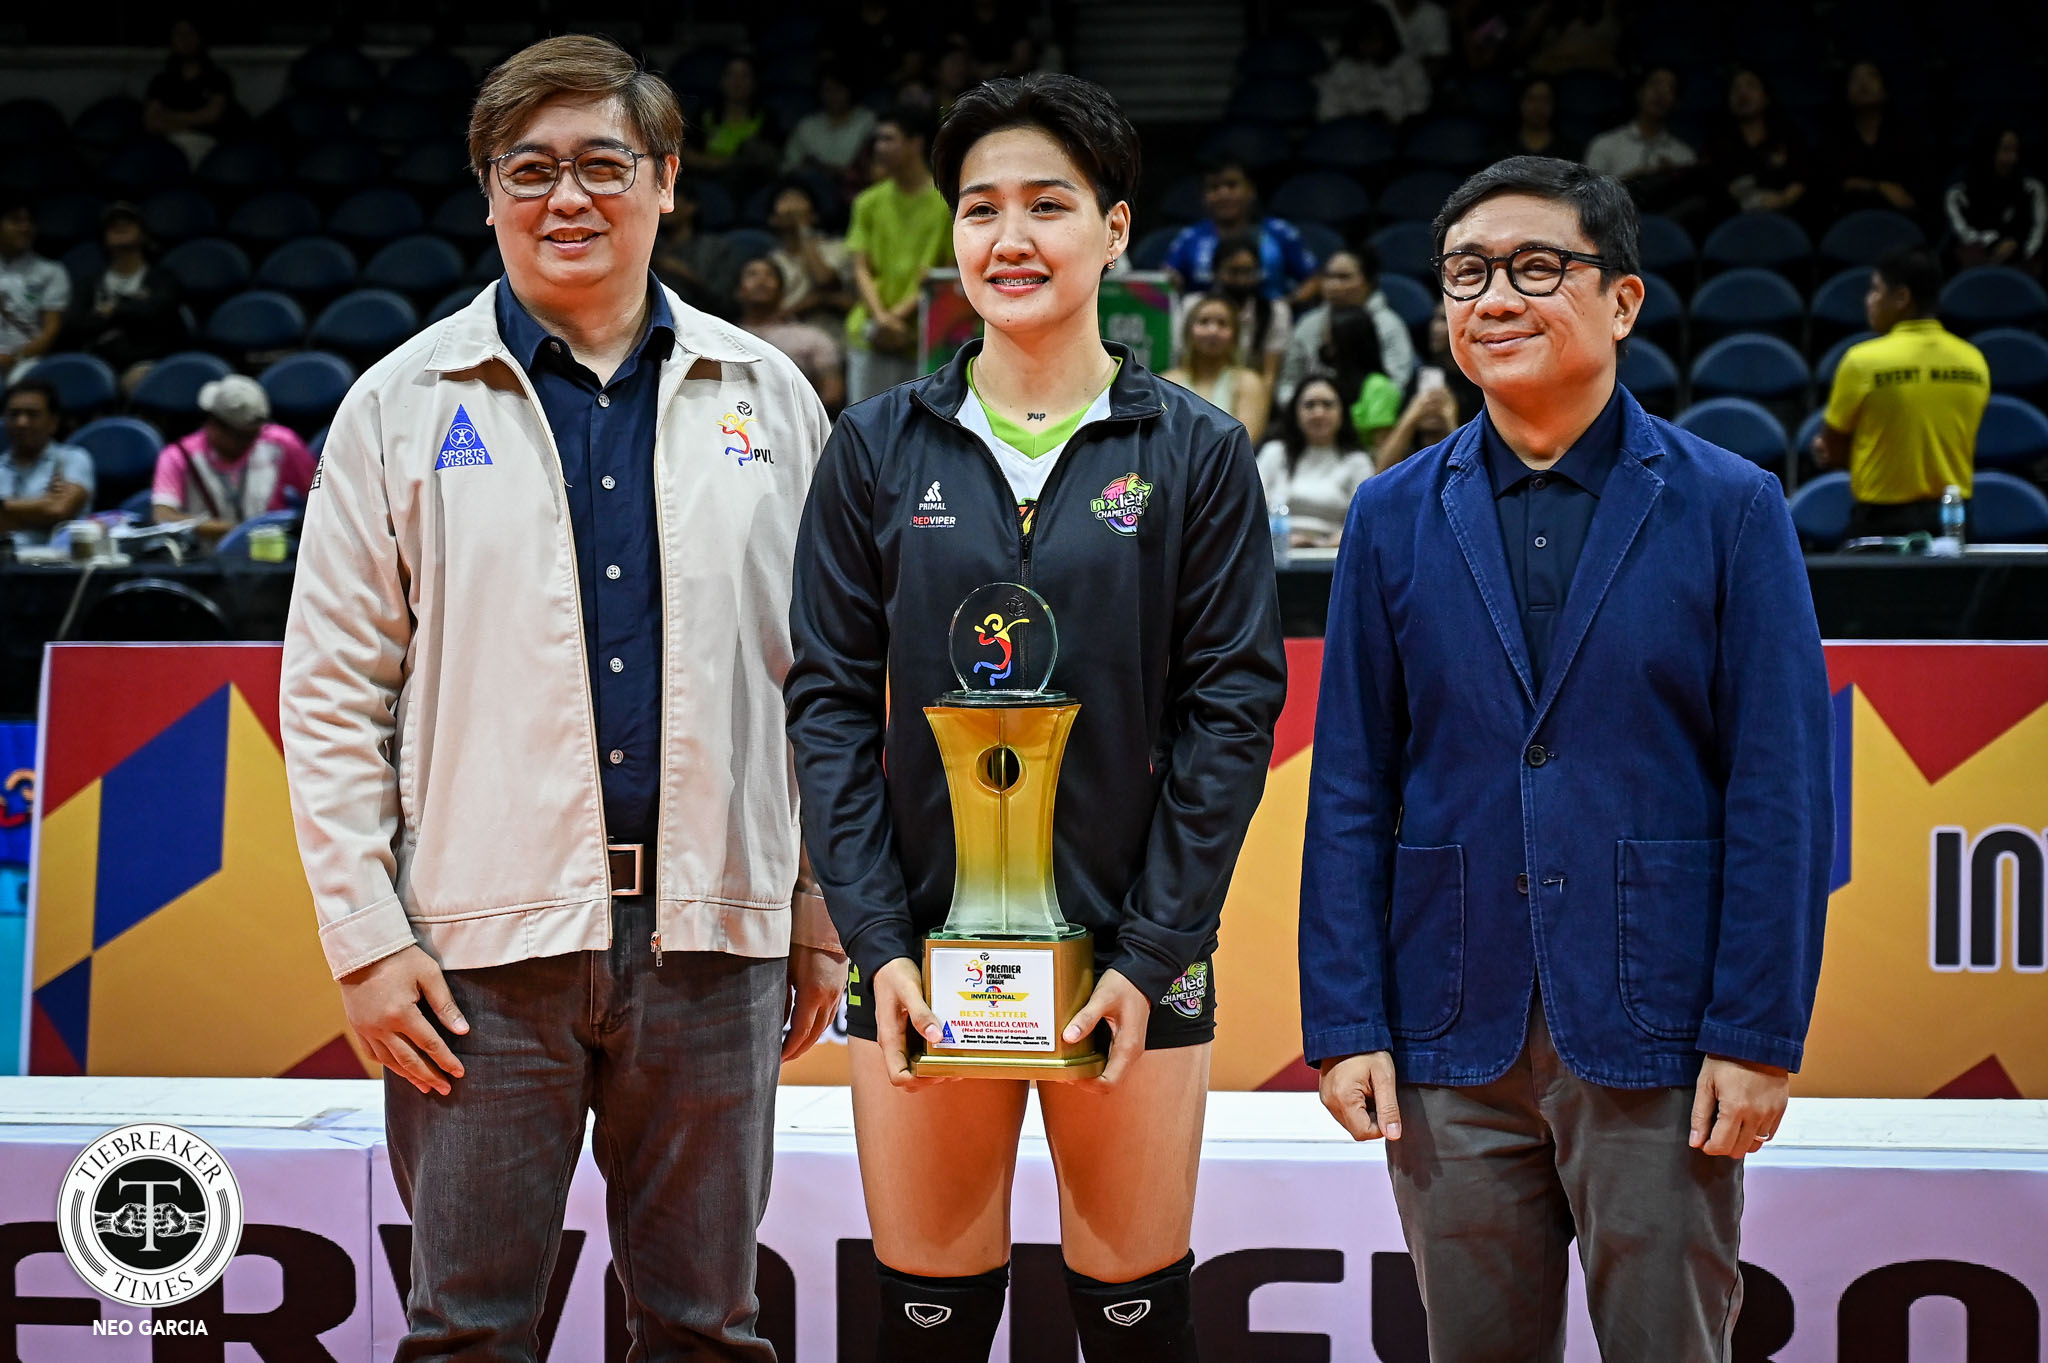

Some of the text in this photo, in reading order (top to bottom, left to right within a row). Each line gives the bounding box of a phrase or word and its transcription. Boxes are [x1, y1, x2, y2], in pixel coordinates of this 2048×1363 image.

[1026, 412, 1046, 421] yup
[442, 448, 486, 459] SPORTS
[754, 448, 775, 464] PVL
[443, 456, 486, 467] VISION
[918, 502, 947, 511] PRIMAL
[1931, 825, 2048, 972] IN
[985, 964, 1021, 974] PREMIER
[1171, 972, 1205, 993] xled
[959, 1010, 1028, 1018] BEST SETTER
[974, 1020, 1010, 1028] ANGELICA
[1011, 1021, 1039, 1029] CAYUNA
